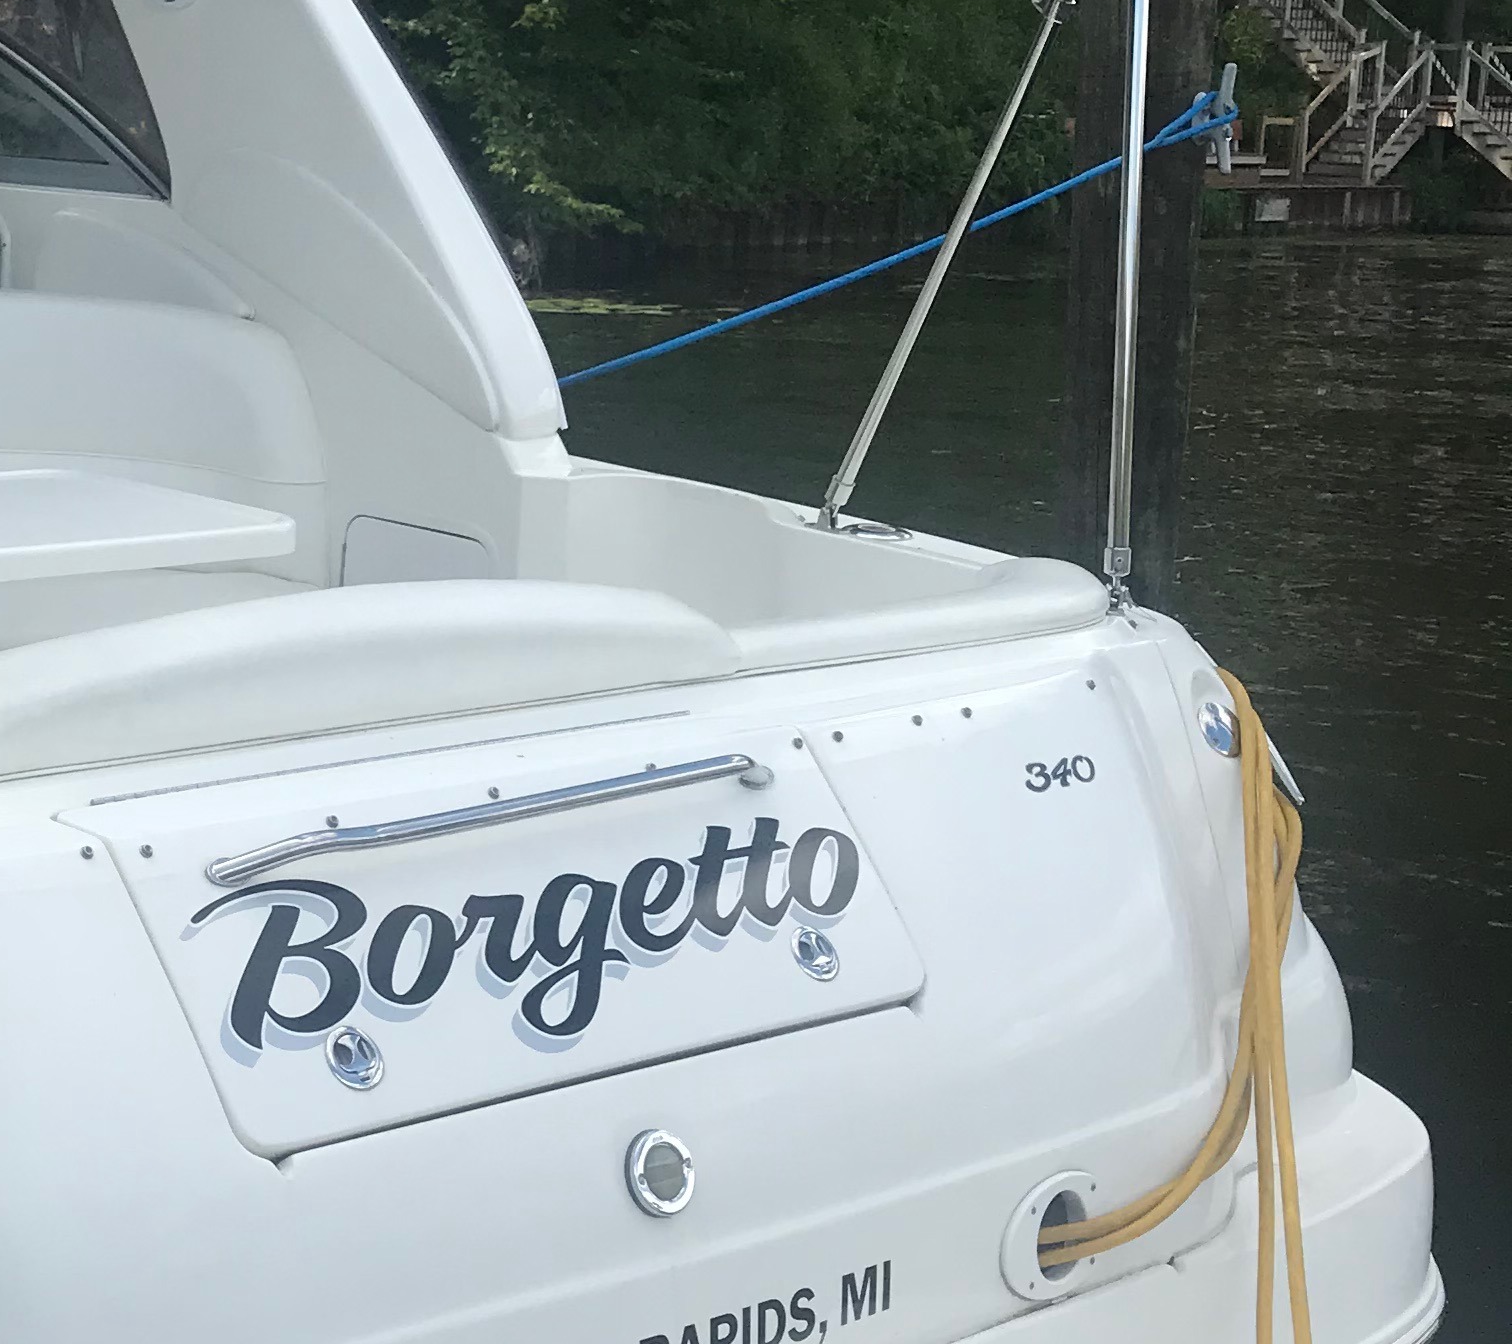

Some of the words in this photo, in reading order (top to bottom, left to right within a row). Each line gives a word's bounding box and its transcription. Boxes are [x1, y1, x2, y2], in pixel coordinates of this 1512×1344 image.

[1024, 754, 1096, 793] 340
[188, 815, 861, 1054] Borgetto
[840, 1259, 893, 1327] MI
